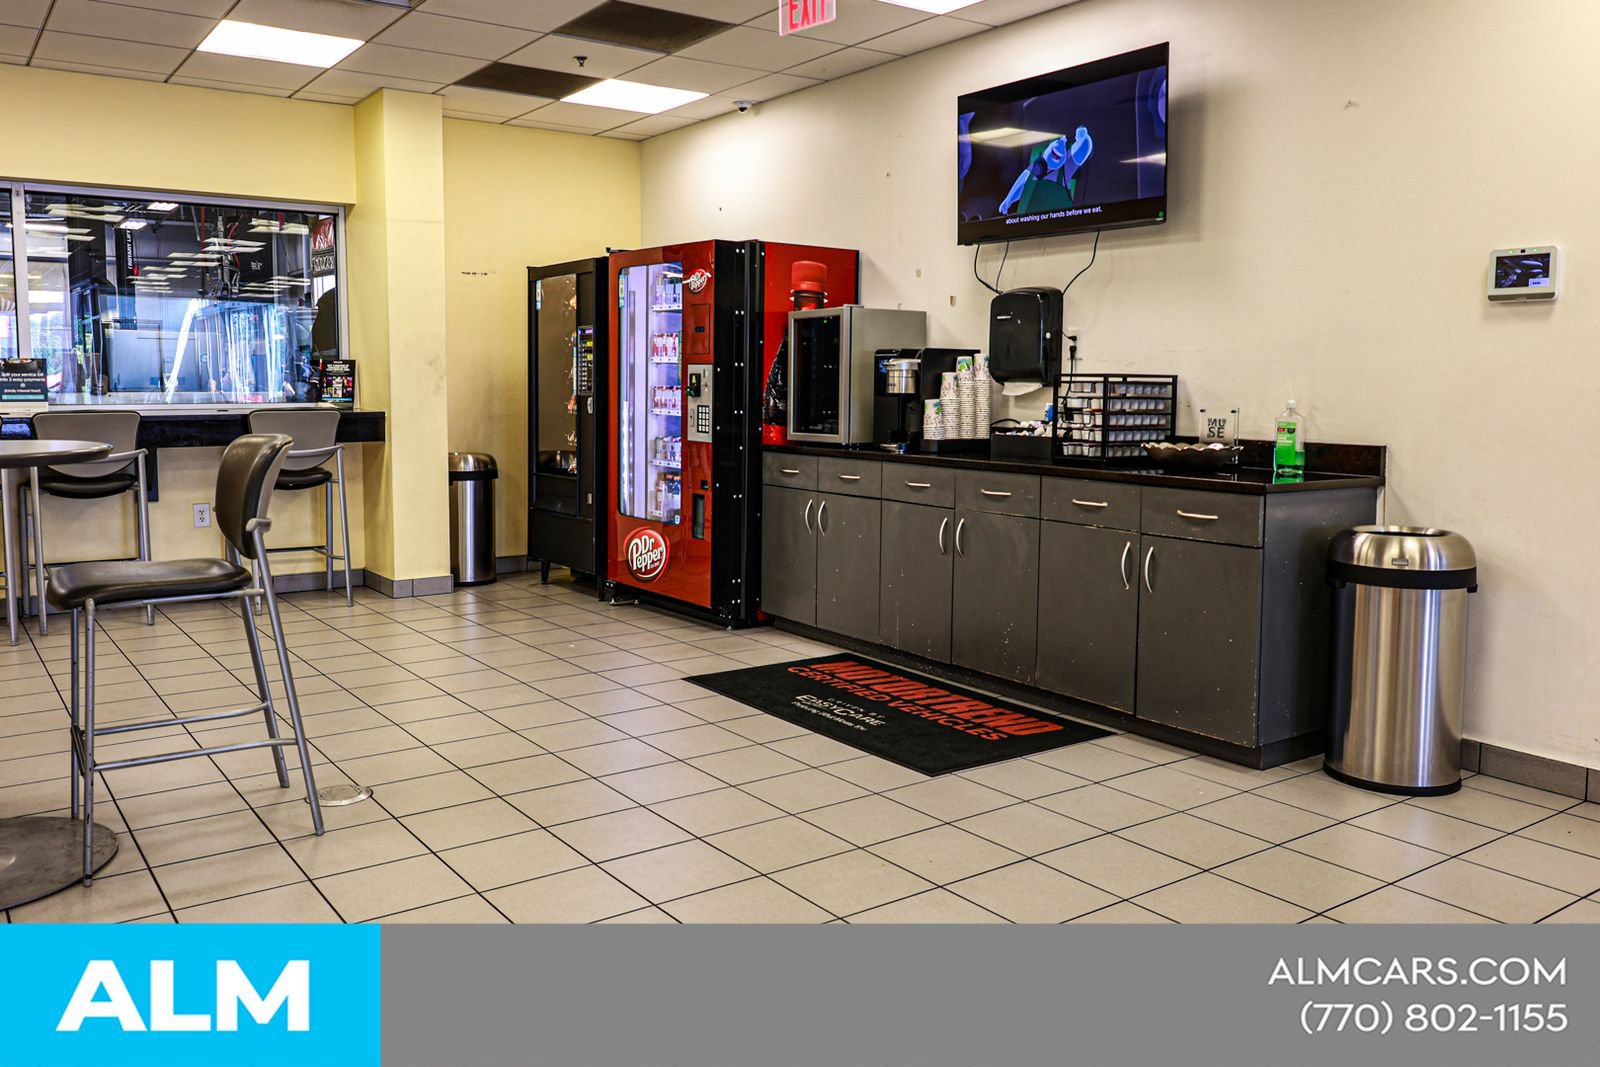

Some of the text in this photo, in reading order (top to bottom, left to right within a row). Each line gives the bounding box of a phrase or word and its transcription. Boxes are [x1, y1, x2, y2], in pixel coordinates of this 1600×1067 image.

[1020, 214, 1040, 223] washing
[1049, 211, 1066, 219] hands
[629, 538, 663, 572] Pepper
[641, 535, 655, 554] Dr
[787, 666, 891, 701] CERTIFIED
[887, 700, 1008, 740] VEHICLES
